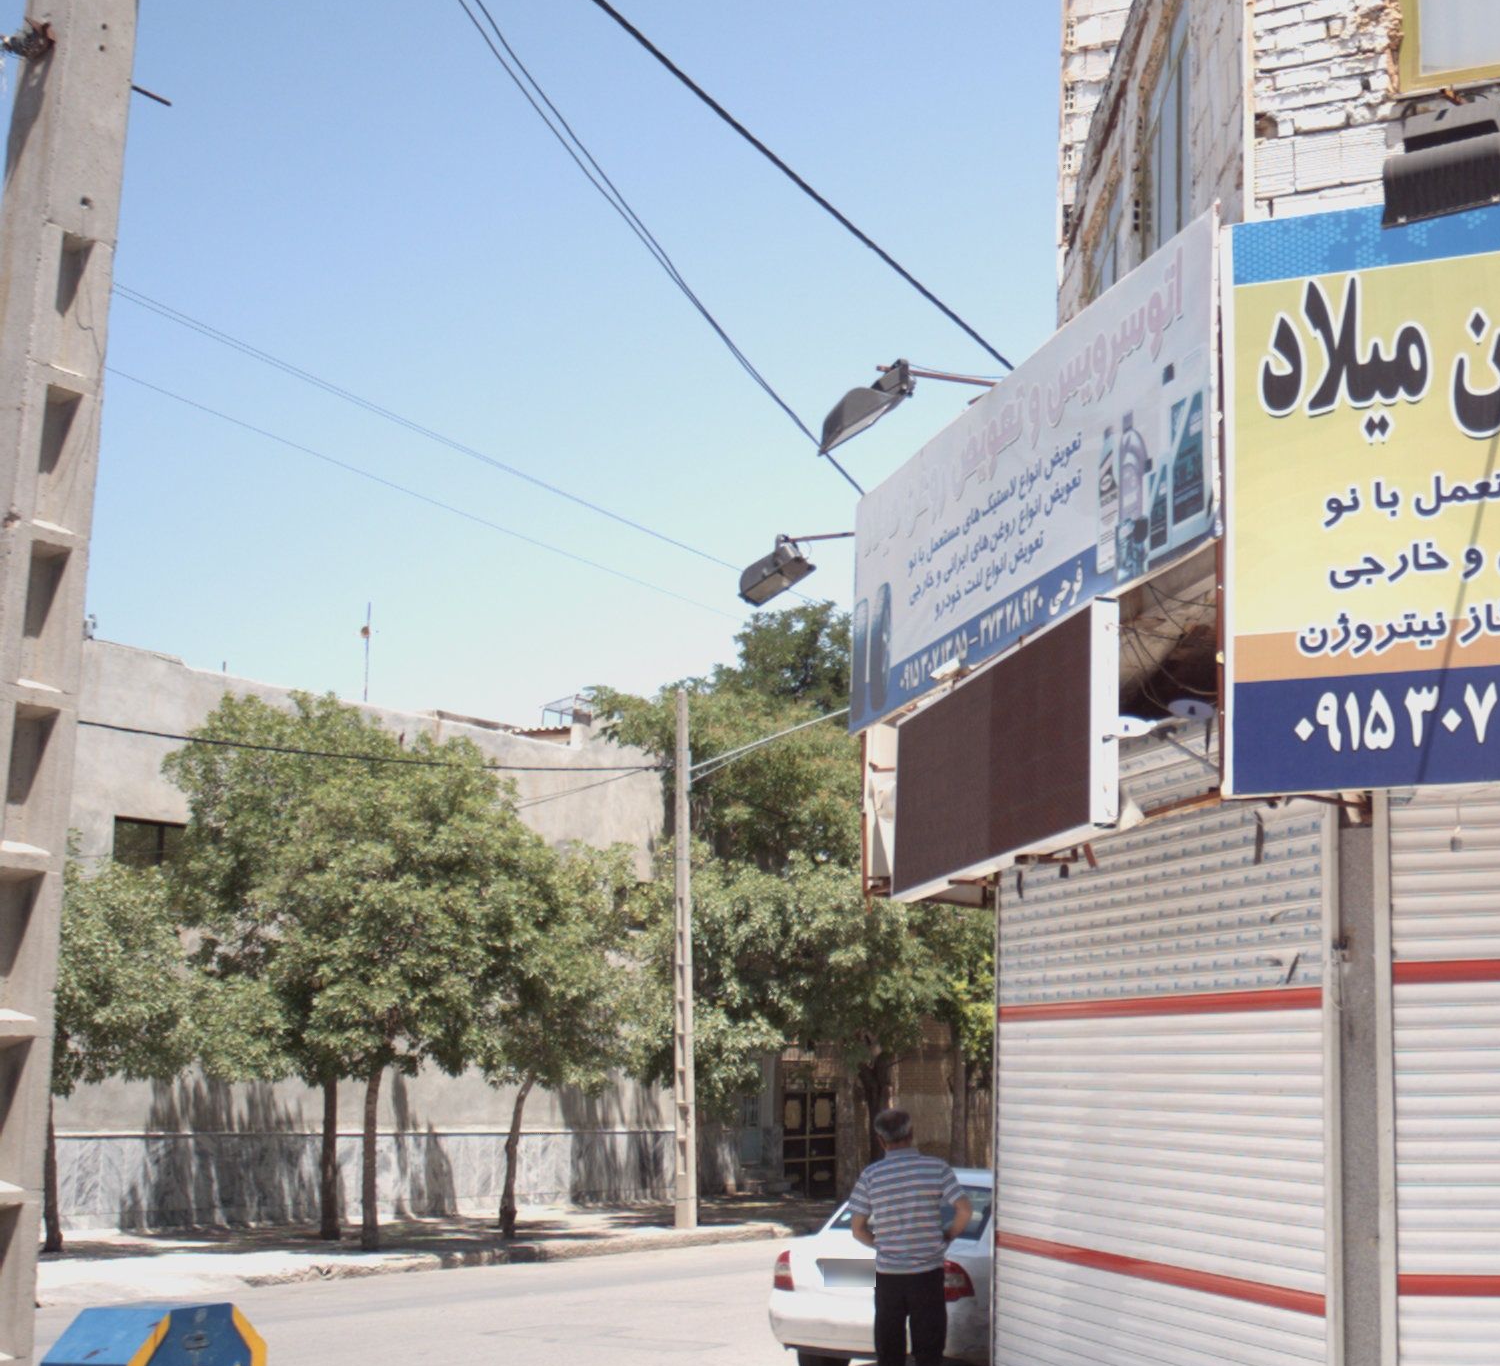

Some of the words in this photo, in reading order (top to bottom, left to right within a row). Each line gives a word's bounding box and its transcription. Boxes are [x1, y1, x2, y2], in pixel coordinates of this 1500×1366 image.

[1261, 274, 1430, 442] میلاد
[1045, 432, 1082, 480] تعویض
[1019, 458, 1042, 500] انواع
[1045, 469, 1082, 516] تعویض
[1374, 482, 1400, 517] با
[1019, 494, 1042, 535] انواع
[1324, 488, 1360, 528] نو
[908, 552, 917, 577] نو
[926, 526, 960, 563] مستعمل
[944, 544, 969, 583] ایرانی
[1009, 530, 1044, 575] تعویض
[1463, 547, 1483, 579] و
[985, 552, 1007, 592] انواع
[1329, 542, 1449, 589] خارجی
[1300, 611, 1447, 653] نیتروژن
